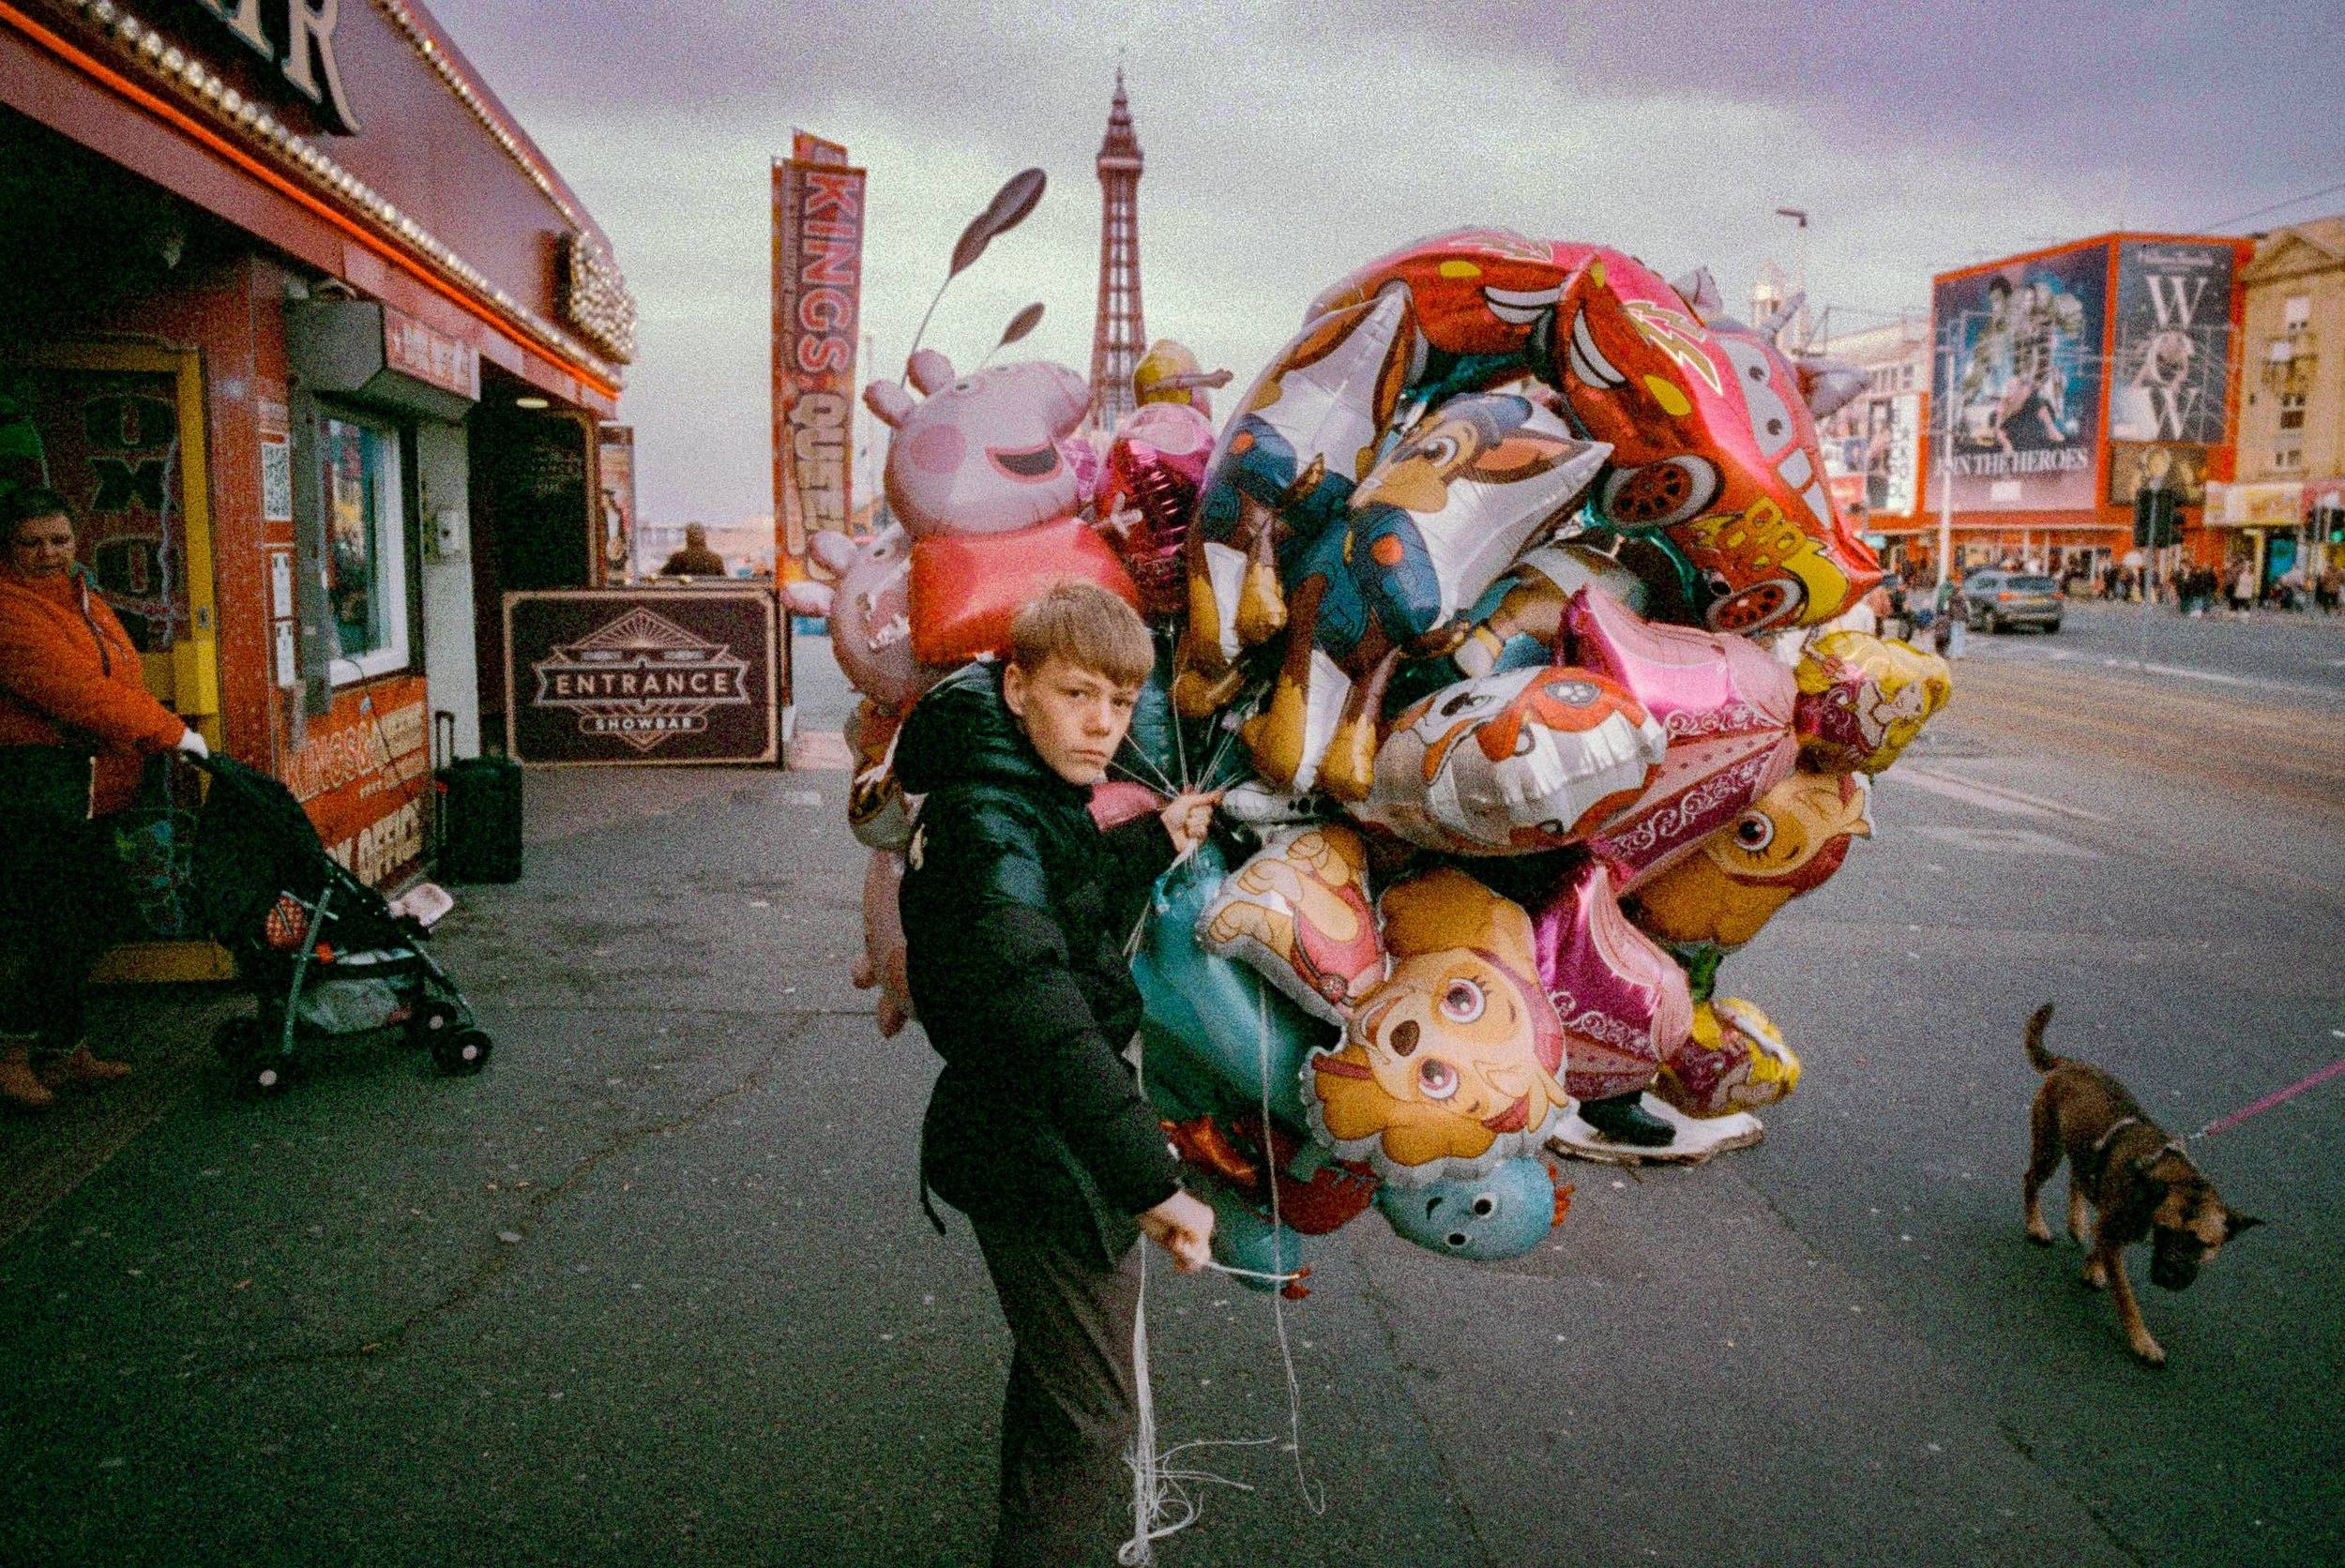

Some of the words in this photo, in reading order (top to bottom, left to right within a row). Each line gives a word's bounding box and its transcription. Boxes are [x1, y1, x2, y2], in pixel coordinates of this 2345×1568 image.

[798, 172, 858, 372] KINGS
[2012, 446, 2089, 472] HEROES
[556, 672, 729, 694] ENTRANCE
[595, 716, 692, 731] SHOWBAR
